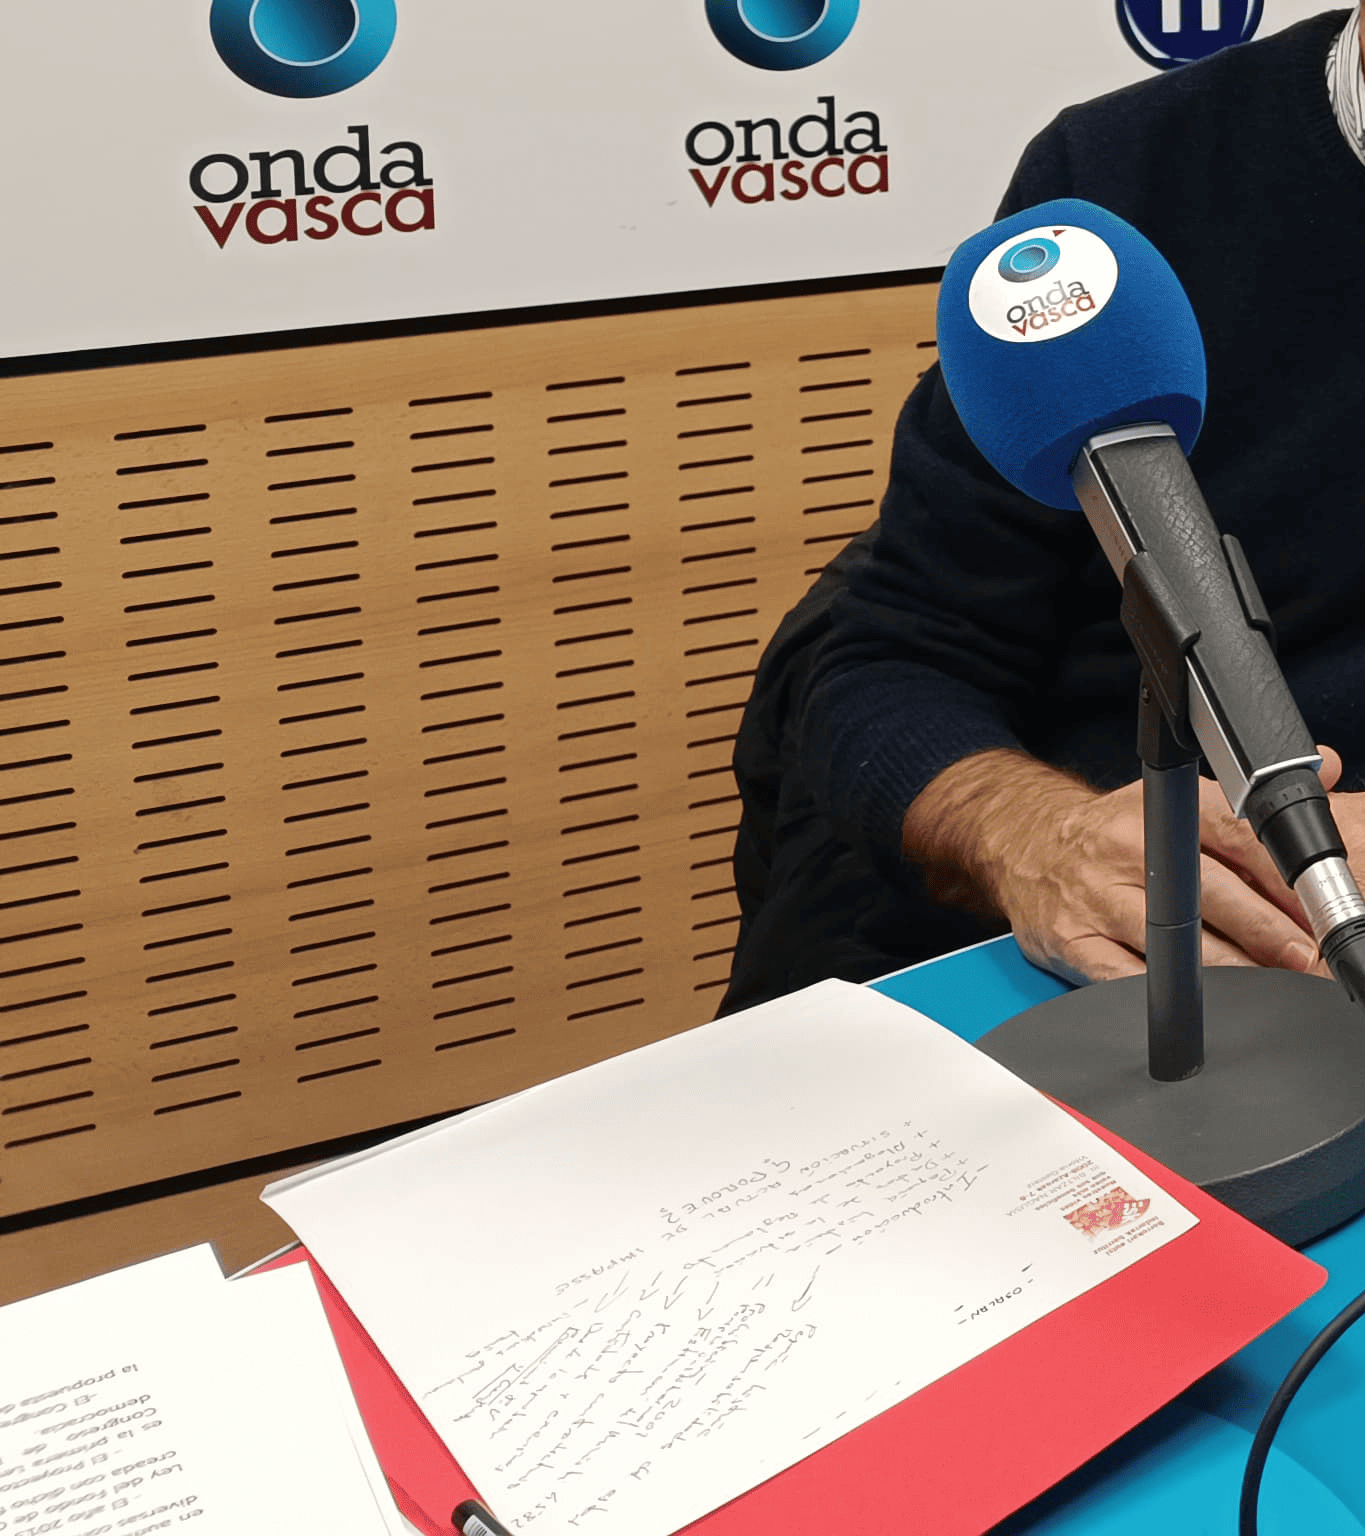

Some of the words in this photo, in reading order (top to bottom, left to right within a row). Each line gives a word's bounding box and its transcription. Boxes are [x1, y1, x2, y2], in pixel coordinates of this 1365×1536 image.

[685, 96, 888, 166] onda
[189, 125, 434, 203] onda
[688, 151, 890, 208] vasca
[193, 186, 436, 250] vasca
[1006, 280, 1090, 325] onda
[1011, 293, 1096, 337] vasca
